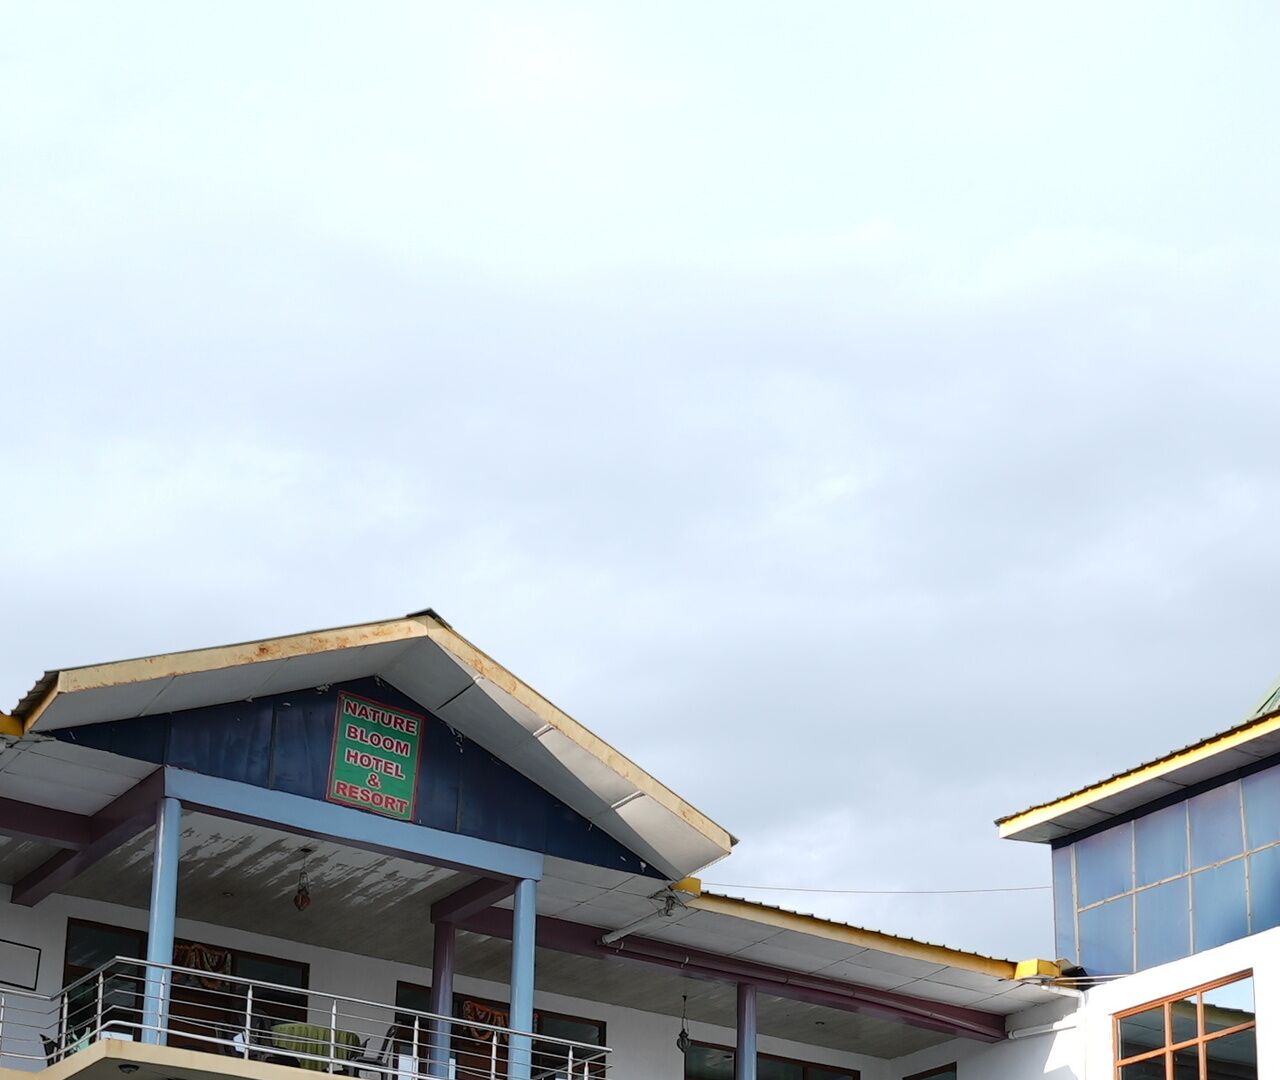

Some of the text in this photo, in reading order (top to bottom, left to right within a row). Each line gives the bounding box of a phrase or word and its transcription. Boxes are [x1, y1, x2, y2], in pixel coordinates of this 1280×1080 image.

[345, 701, 417, 734] NATURE
[347, 725, 410, 756] BLOOM
[345, 750, 404, 778] HOTEL
[367, 772, 381, 788] &
[336, 782, 407, 813] RESORT
